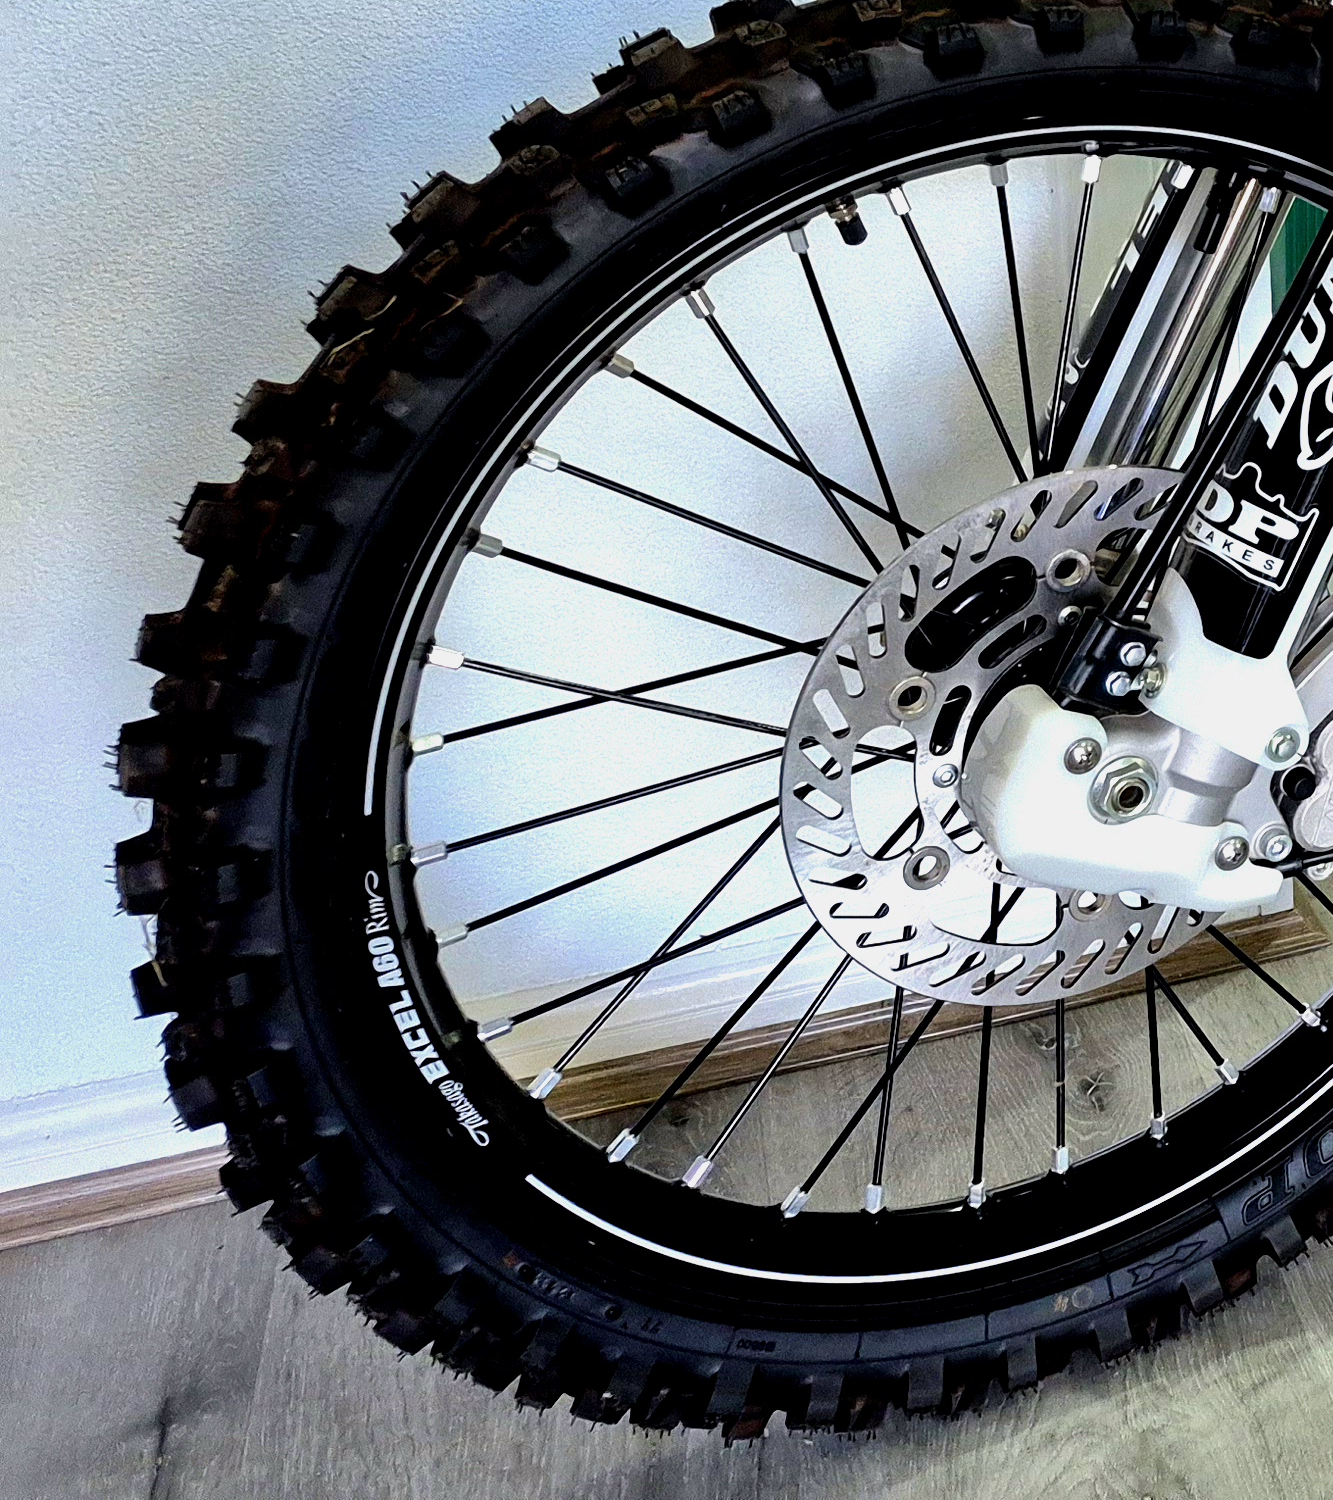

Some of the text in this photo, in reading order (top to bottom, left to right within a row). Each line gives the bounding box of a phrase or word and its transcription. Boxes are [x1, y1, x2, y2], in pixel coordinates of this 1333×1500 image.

[1188, 515, 1275, 571] RAKES
[1196, 479, 1299, 544] DP
[364, 870, 489, 1147] Takasago EXCEL A60 Rim
